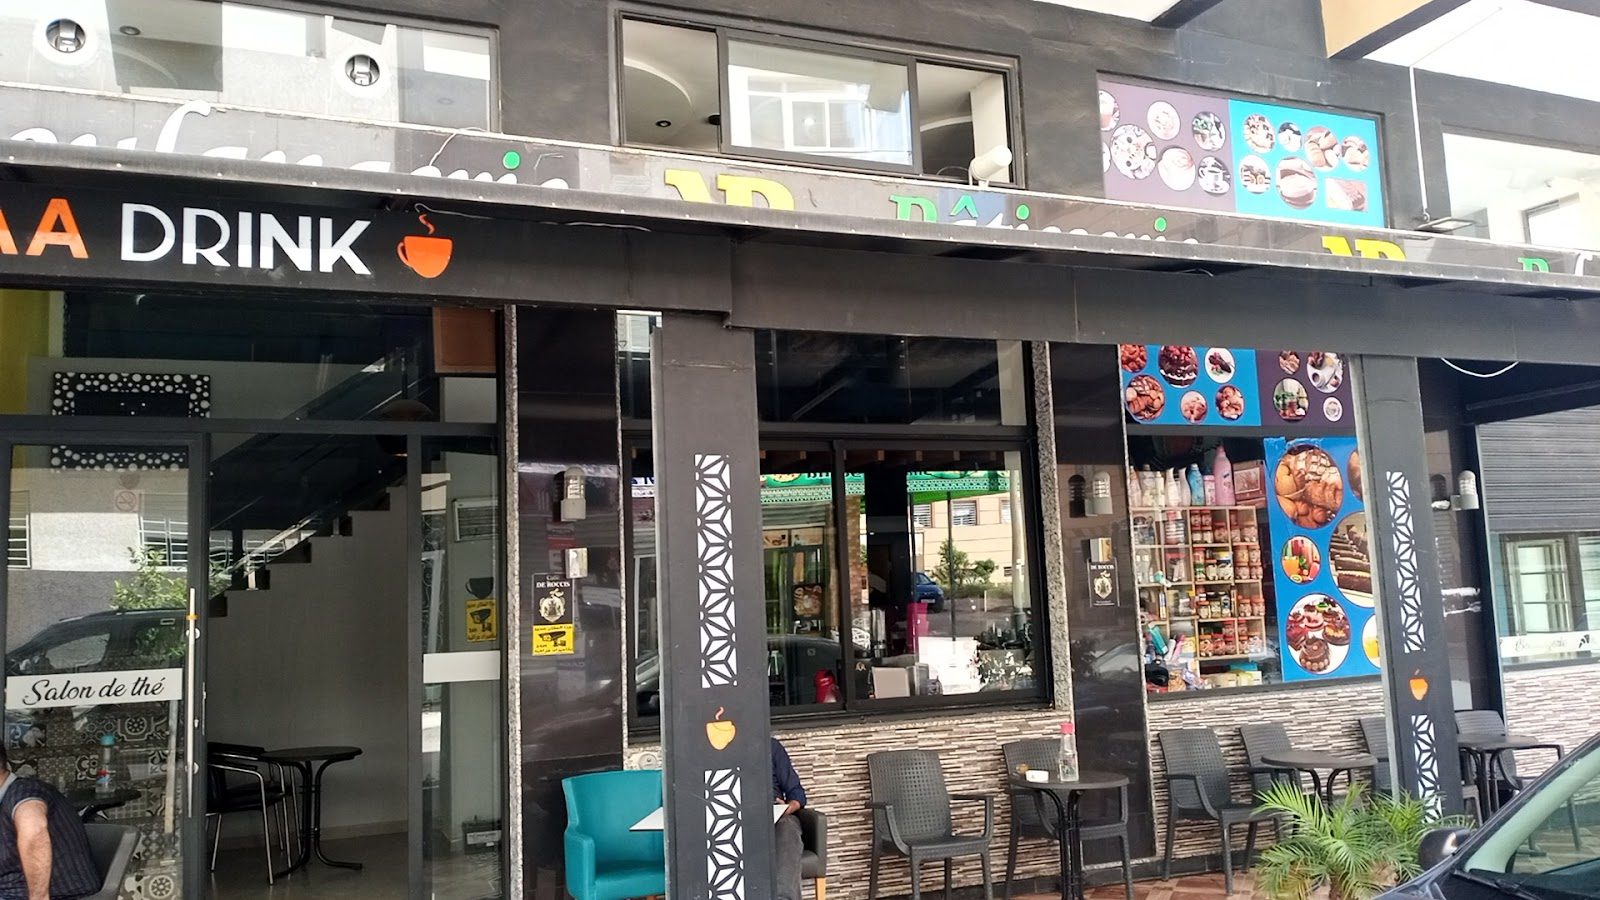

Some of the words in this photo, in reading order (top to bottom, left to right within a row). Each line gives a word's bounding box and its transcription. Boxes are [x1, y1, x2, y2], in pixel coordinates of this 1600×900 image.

[121, 203, 372, 276] DRINK
[22, 679, 96, 705] Salon
[98, 677, 127, 698] de
[131, 676, 166, 696] thé
